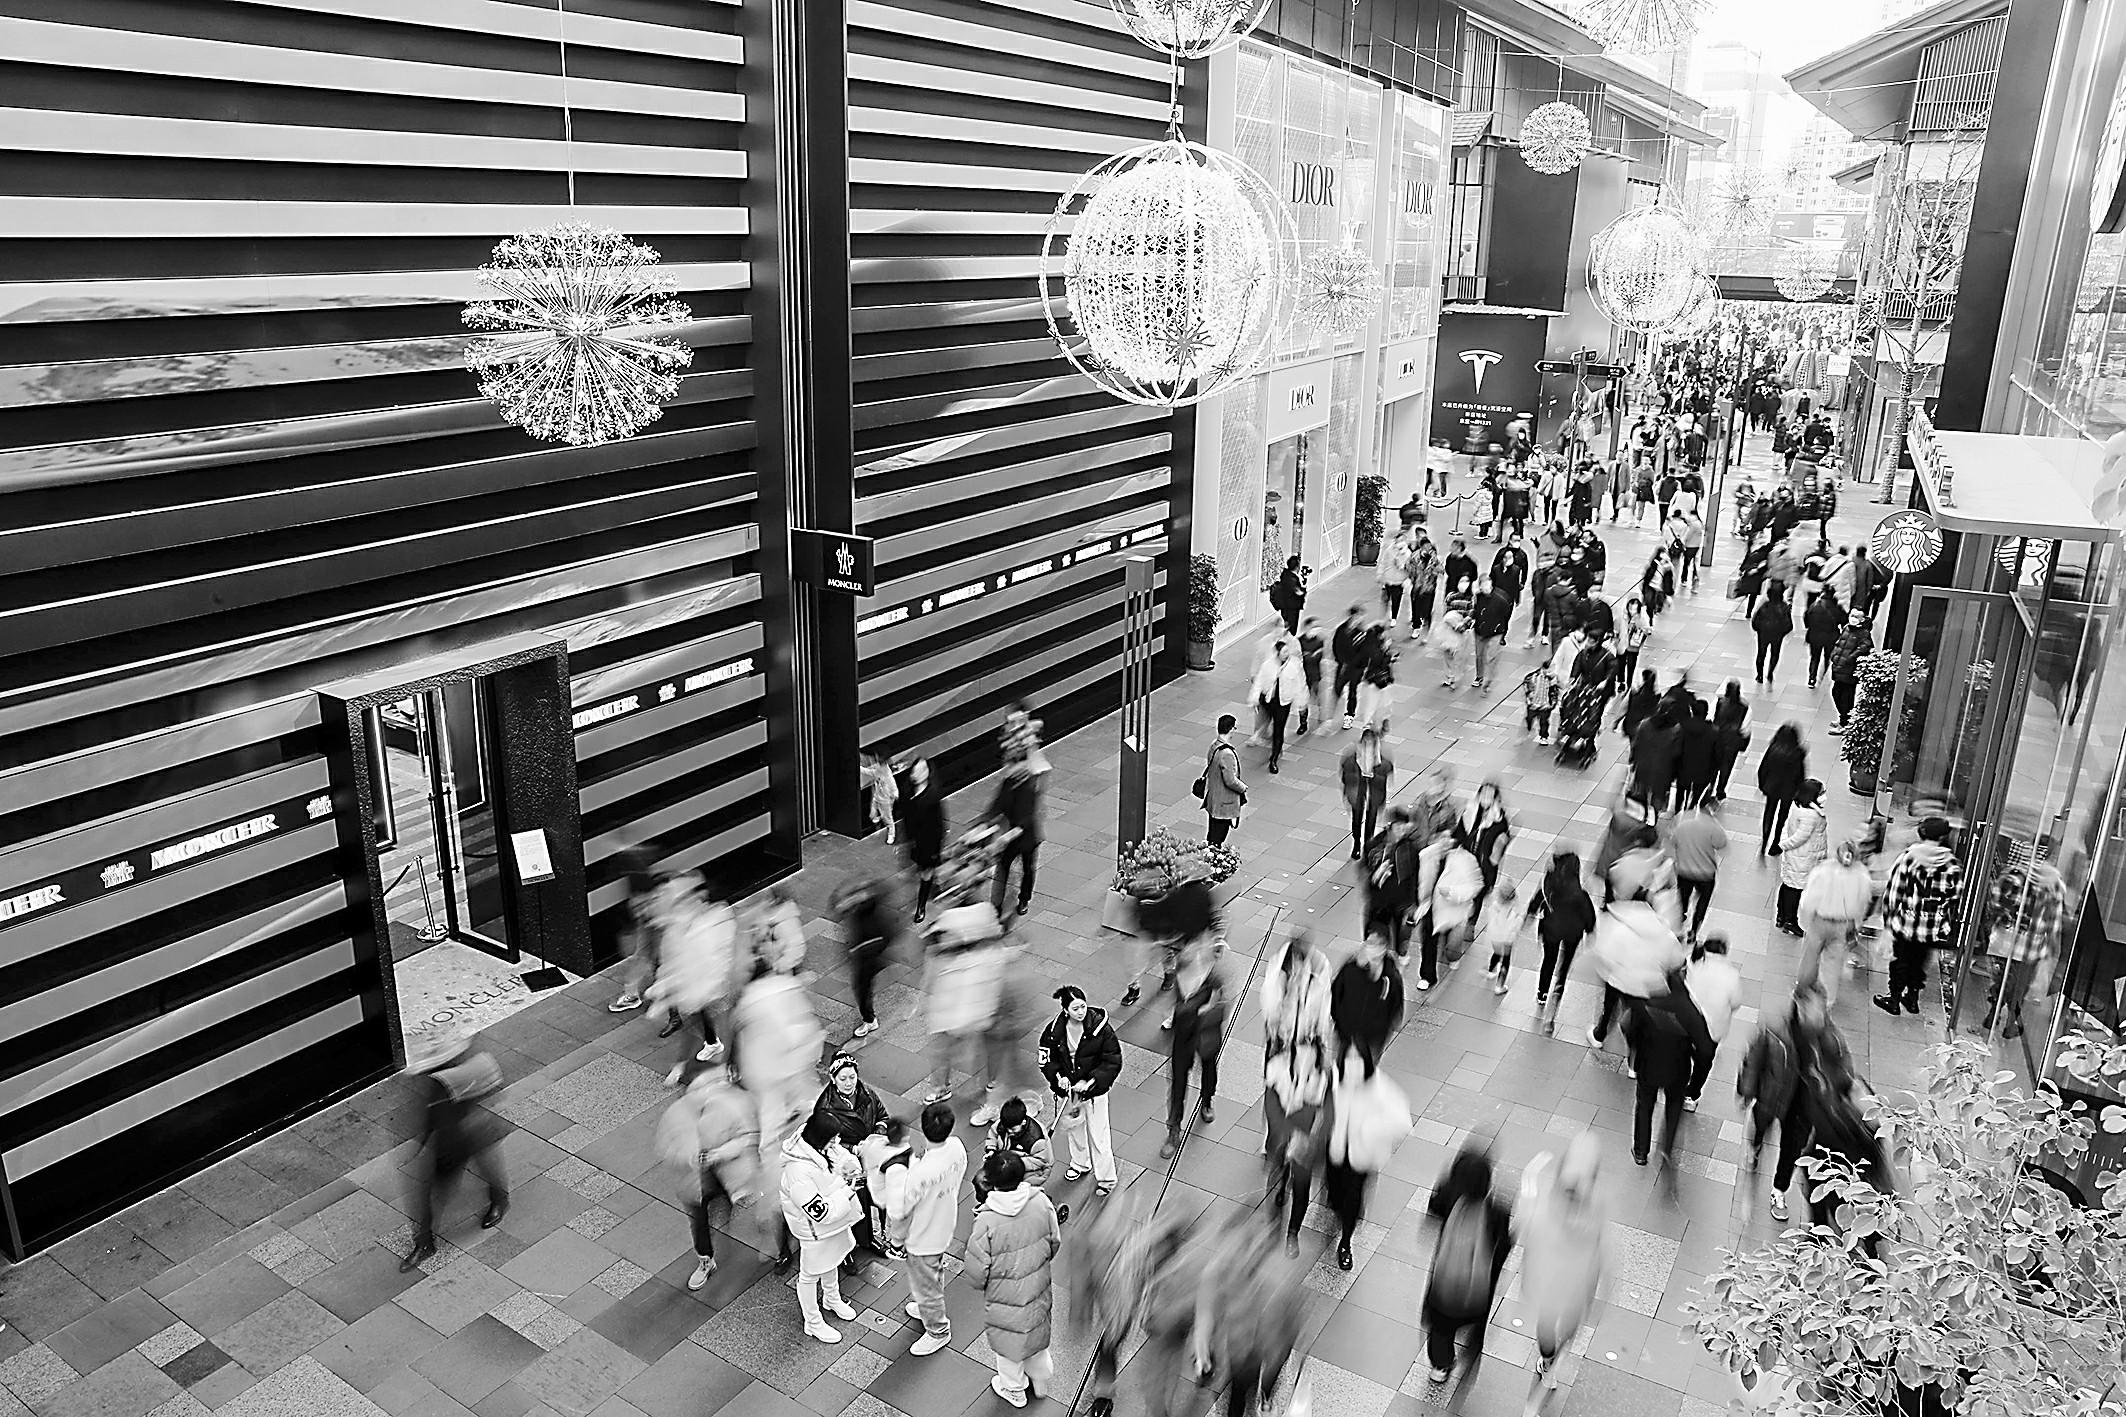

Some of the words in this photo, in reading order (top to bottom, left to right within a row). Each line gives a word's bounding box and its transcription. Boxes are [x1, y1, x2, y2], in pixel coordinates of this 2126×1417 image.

[1291, 161, 1334, 207] DIOR
[1404, 180, 1433, 215] DIOR
[828, 578, 863, 592] MONCLER
[151, 813, 280, 871] MONCLER
[407, 974, 521, 1036] MONCLER
